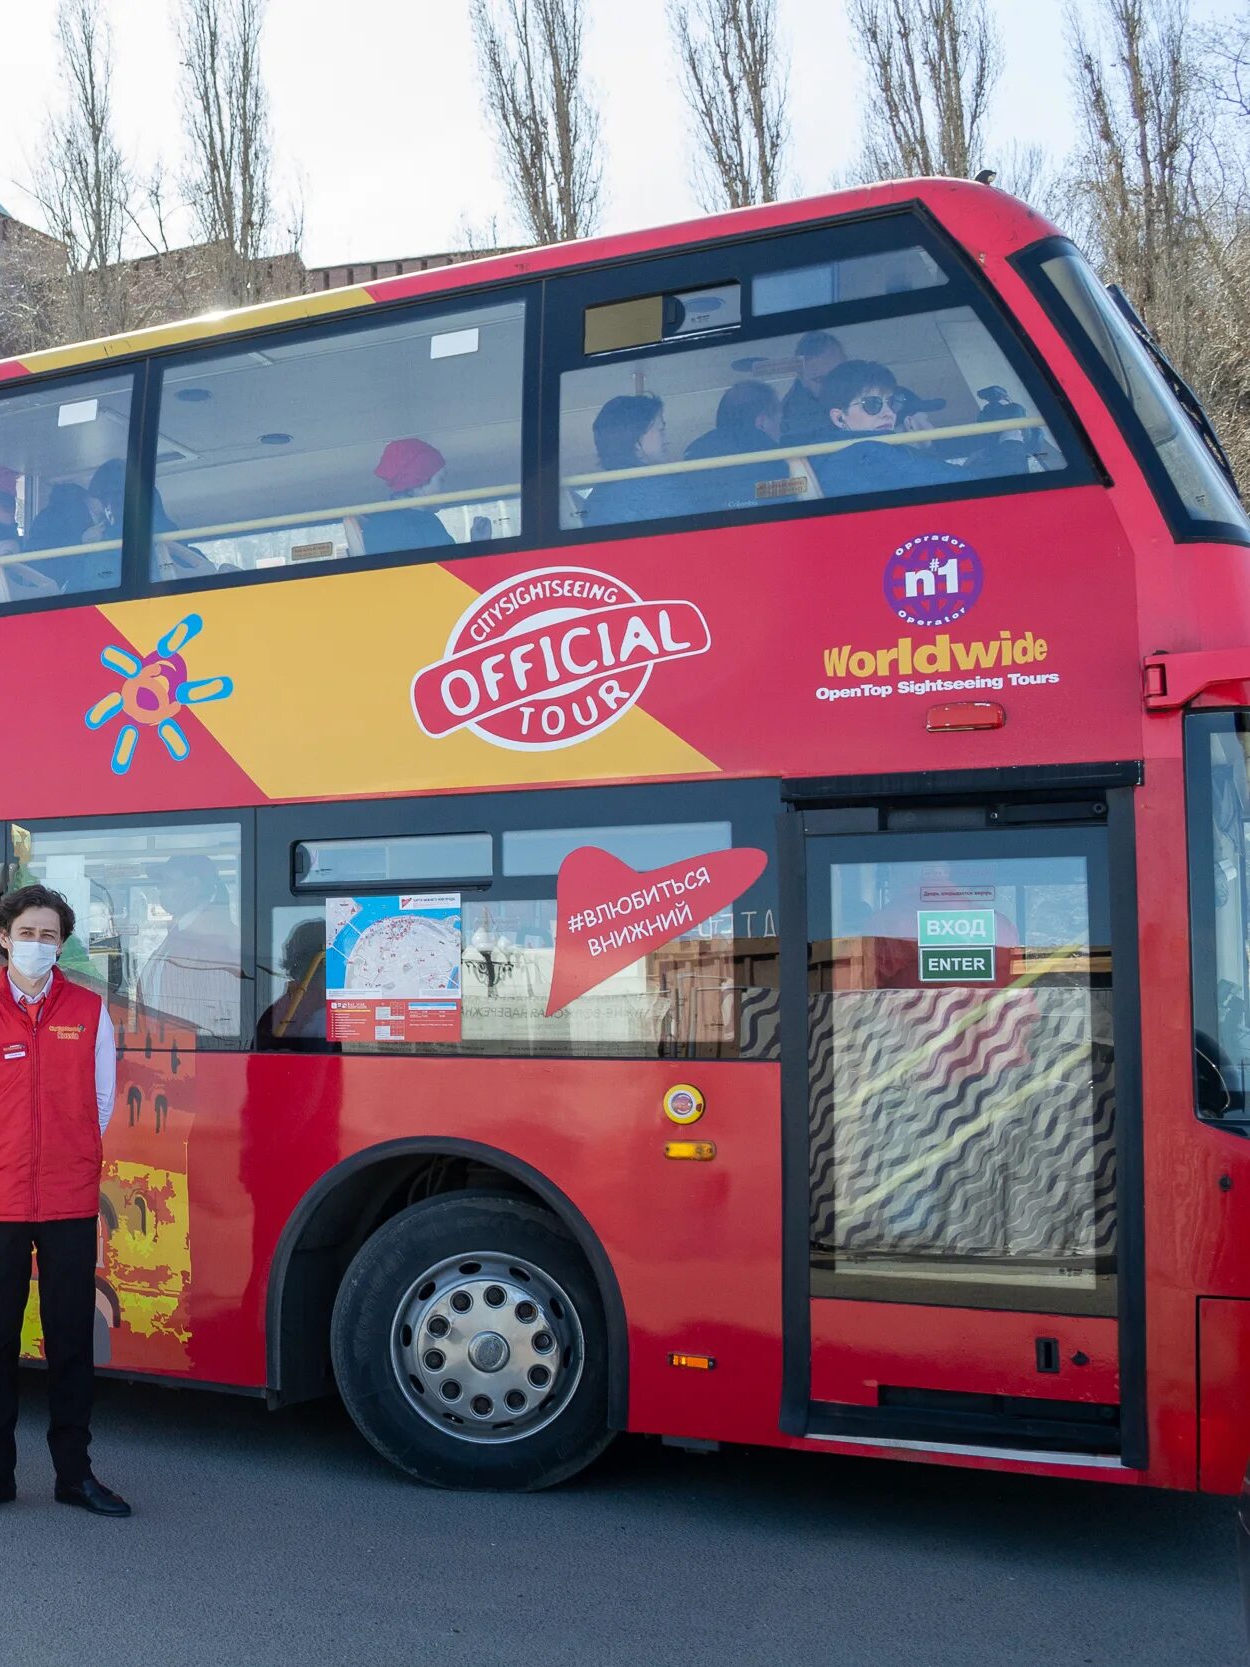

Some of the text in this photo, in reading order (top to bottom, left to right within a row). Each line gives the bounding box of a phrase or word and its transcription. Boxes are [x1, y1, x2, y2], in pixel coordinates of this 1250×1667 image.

[895, 534, 966, 556] Operador
[470, 579, 618, 642] CITYSIGHTSEEING
[897, 606, 967, 627] Operator
[440, 609, 691, 716] OFFICIAL
[823, 630, 1048, 678] Worldwide
[519, 679, 631, 736] TOUR
[815, 671, 1060, 702] OpenTop Sightseeing Tours
[567, 866, 711, 934] #ВЛЮБИТЬСЯ
[587, 900, 693, 957] ВНИЖНИЙ
[926, 919, 987, 938] ВХОД
[928, 957, 986, 971] ENTER
